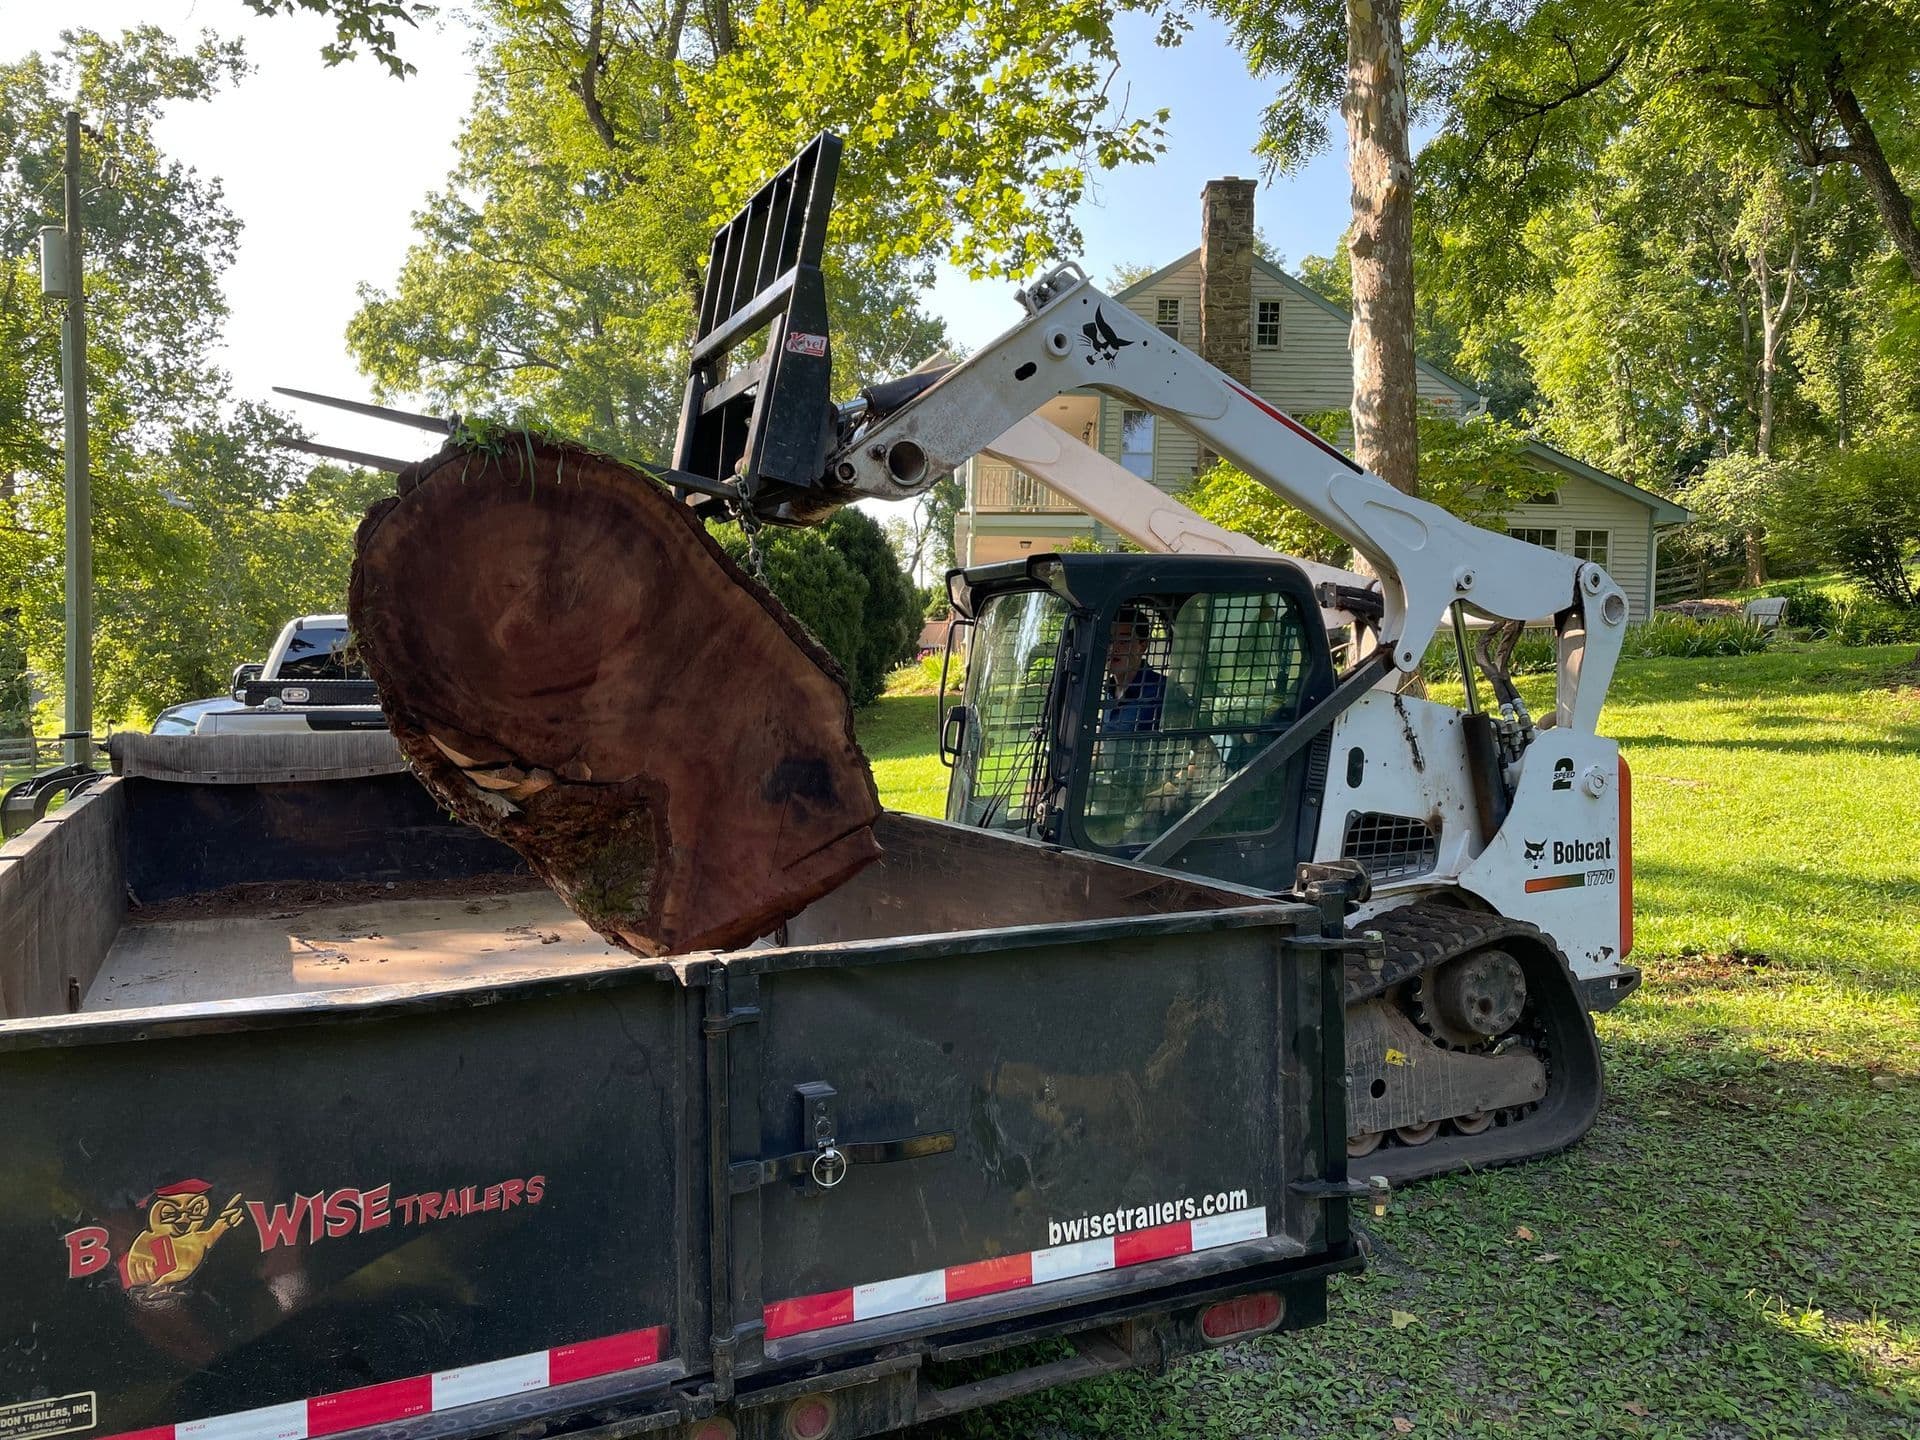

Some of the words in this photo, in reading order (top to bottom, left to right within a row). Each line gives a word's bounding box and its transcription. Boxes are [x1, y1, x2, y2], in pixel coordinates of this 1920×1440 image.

[1552, 758, 1575, 791] 2
[1553, 771, 1575, 780] SPEED
[1553, 837, 1611, 865] Bobcat
[1587, 869, 1615, 887] T770
[65, 1226, 111, 1279] B
[246, 1183, 391, 1253] WISE
[395, 1175, 545, 1226] TRAILERS
[1048, 1188, 1248, 1246] bwisetrailers.com
[23, 1407, 70, 1424] TRAILERS,
[72, 1404, 91, 1415] INC.
